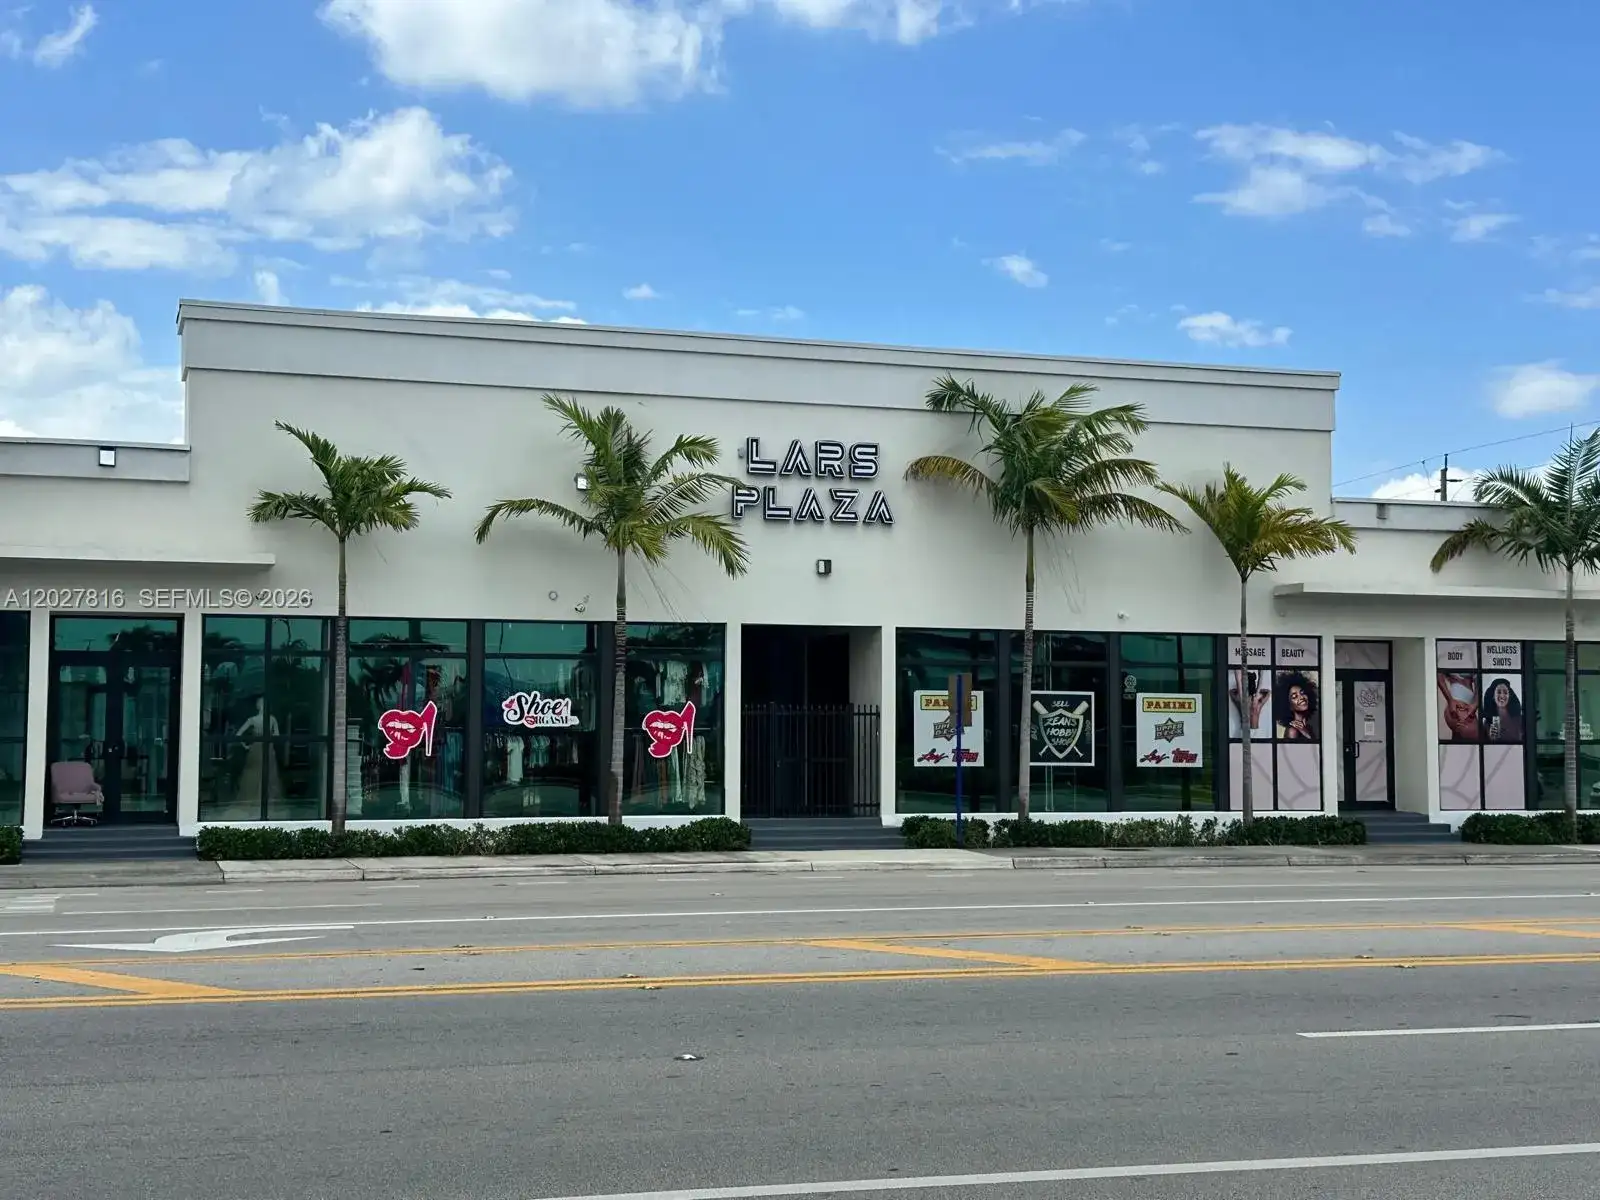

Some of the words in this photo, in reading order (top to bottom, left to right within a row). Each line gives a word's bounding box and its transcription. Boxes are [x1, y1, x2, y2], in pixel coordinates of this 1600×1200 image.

[746, 436, 880, 478] LARS
[731, 485, 895, 524] PLAZA
[1235, 648, 1266, 657] MSSAGE
[1281, 649, 1304, 658] BEAUTY
[1486, 645, 1517, 654] WELLNESS
[1447, 652, 1463, 661] BODY
[1492, 657, 1512, 666] SHOTS
[506, 693, 562, 722] Shoe
[1145, 700, 1193, 710] PANINI
[1047, 727, 1078, 737] HOBBY
